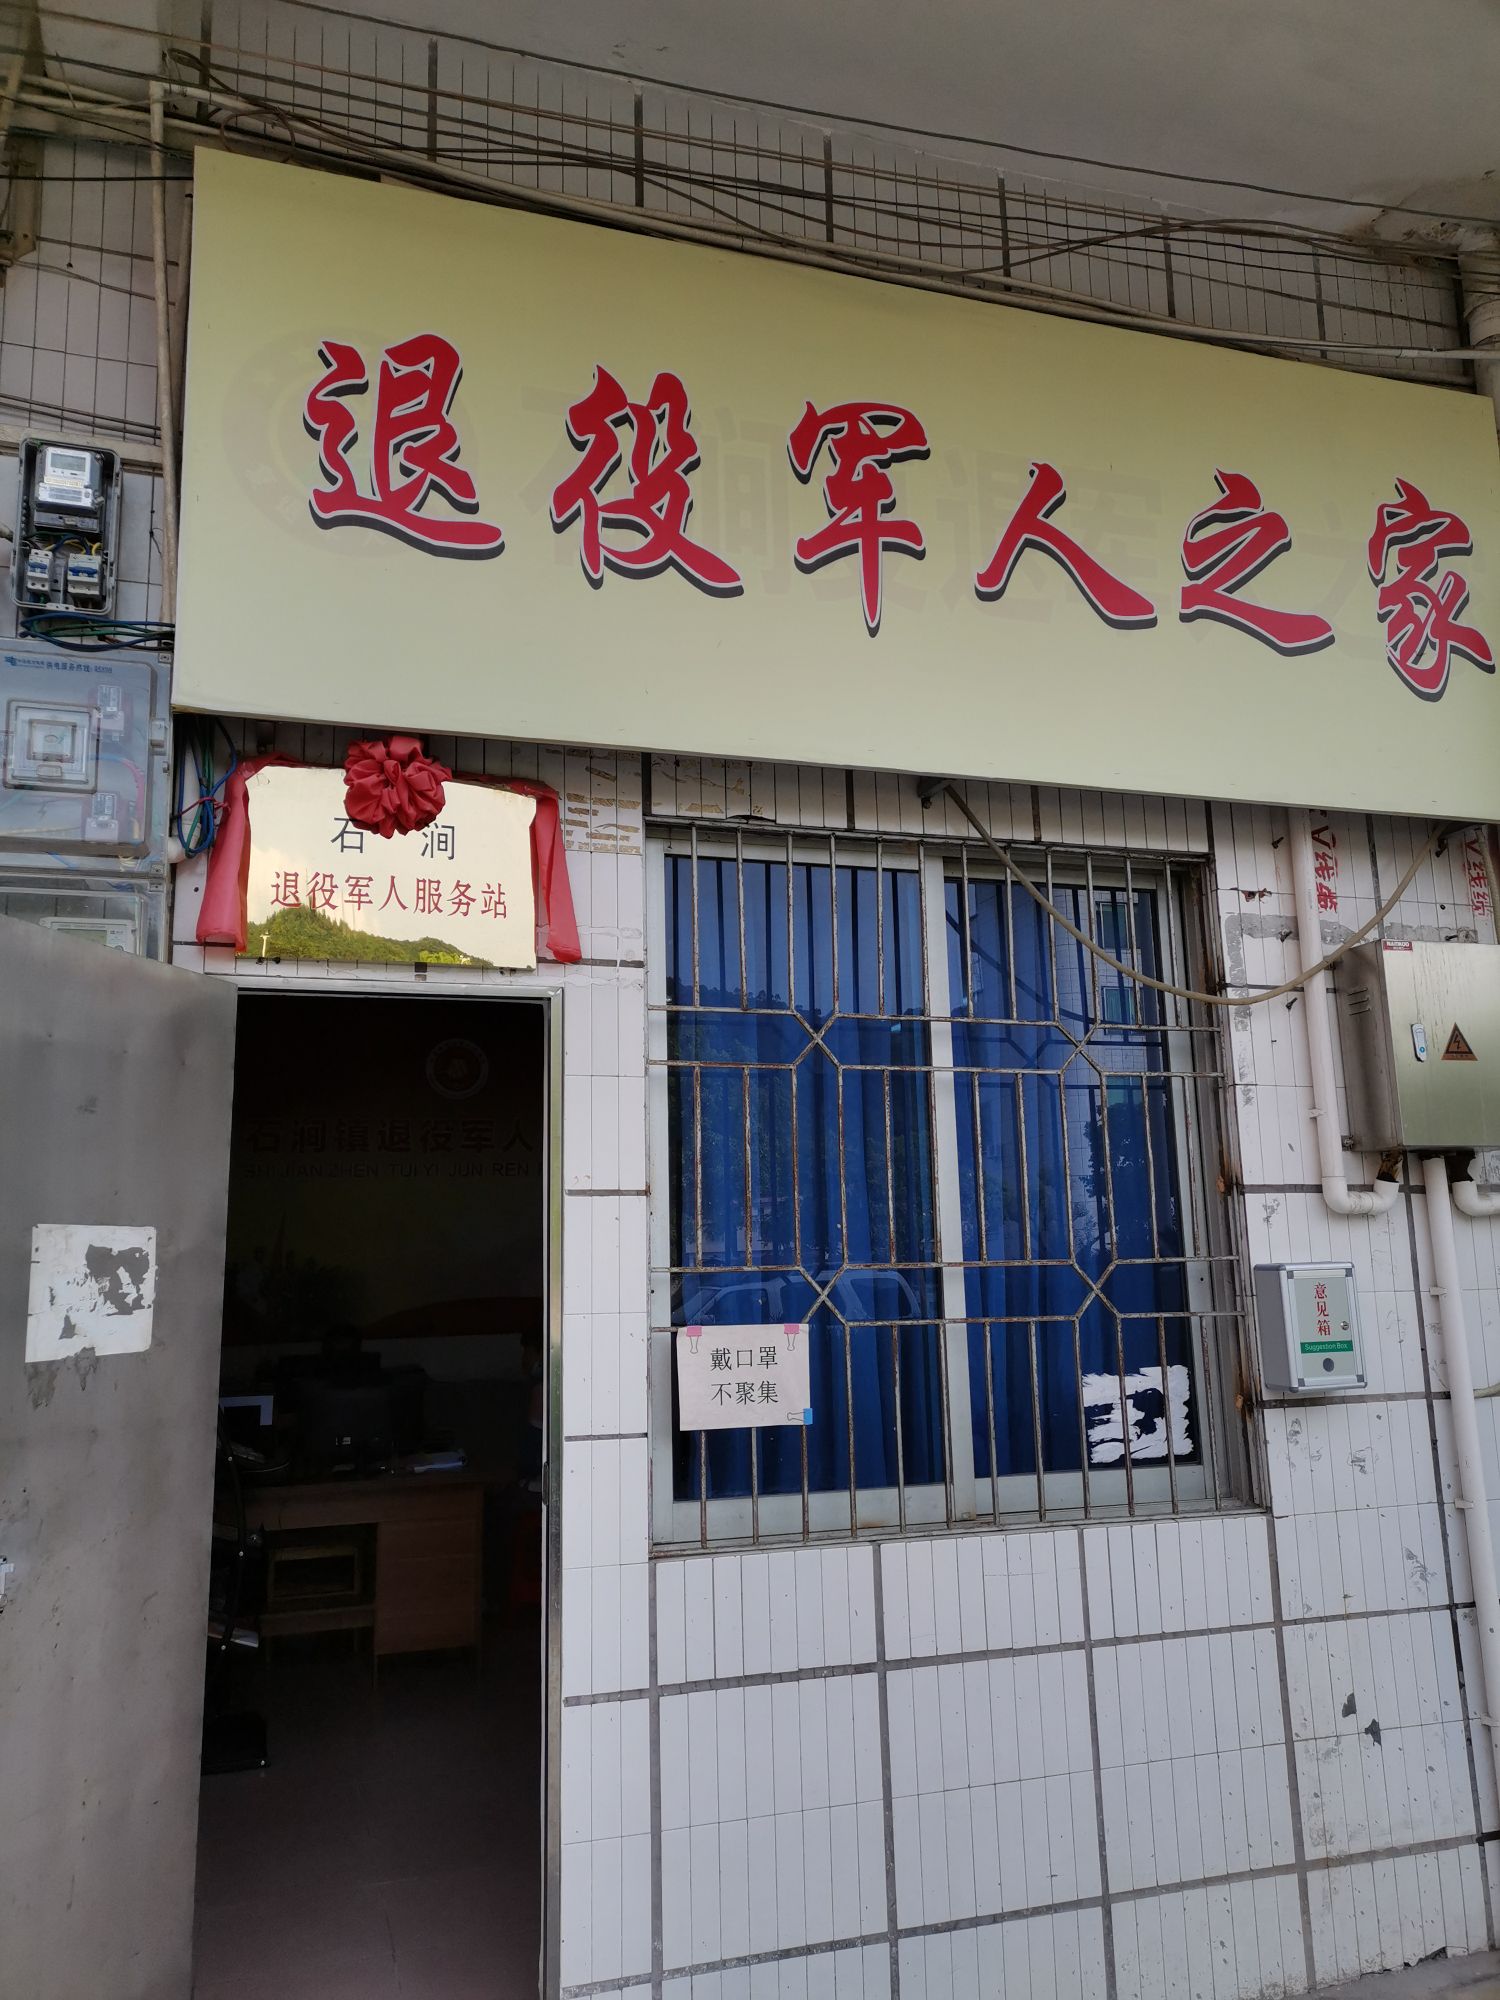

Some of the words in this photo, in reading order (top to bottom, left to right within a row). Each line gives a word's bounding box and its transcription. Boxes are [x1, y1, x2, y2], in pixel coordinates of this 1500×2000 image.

[303, 335, 1496, 702] 退役军人之家
[270, 870, 508, 920] 退役军人服务站
[448, 1162, 484, 1178] JUN
[491, 1161, 530, 1178] REN
[1314, 1282, 1331, 1336] 意见箱
[710, 1346, 778, 1372] 戴口罩
[1304, 1343, 1336, 1352] Suggestion
[1336, 1341, 1349, 1350] Box
[711, 1380, 779, 1407] 不聚集
